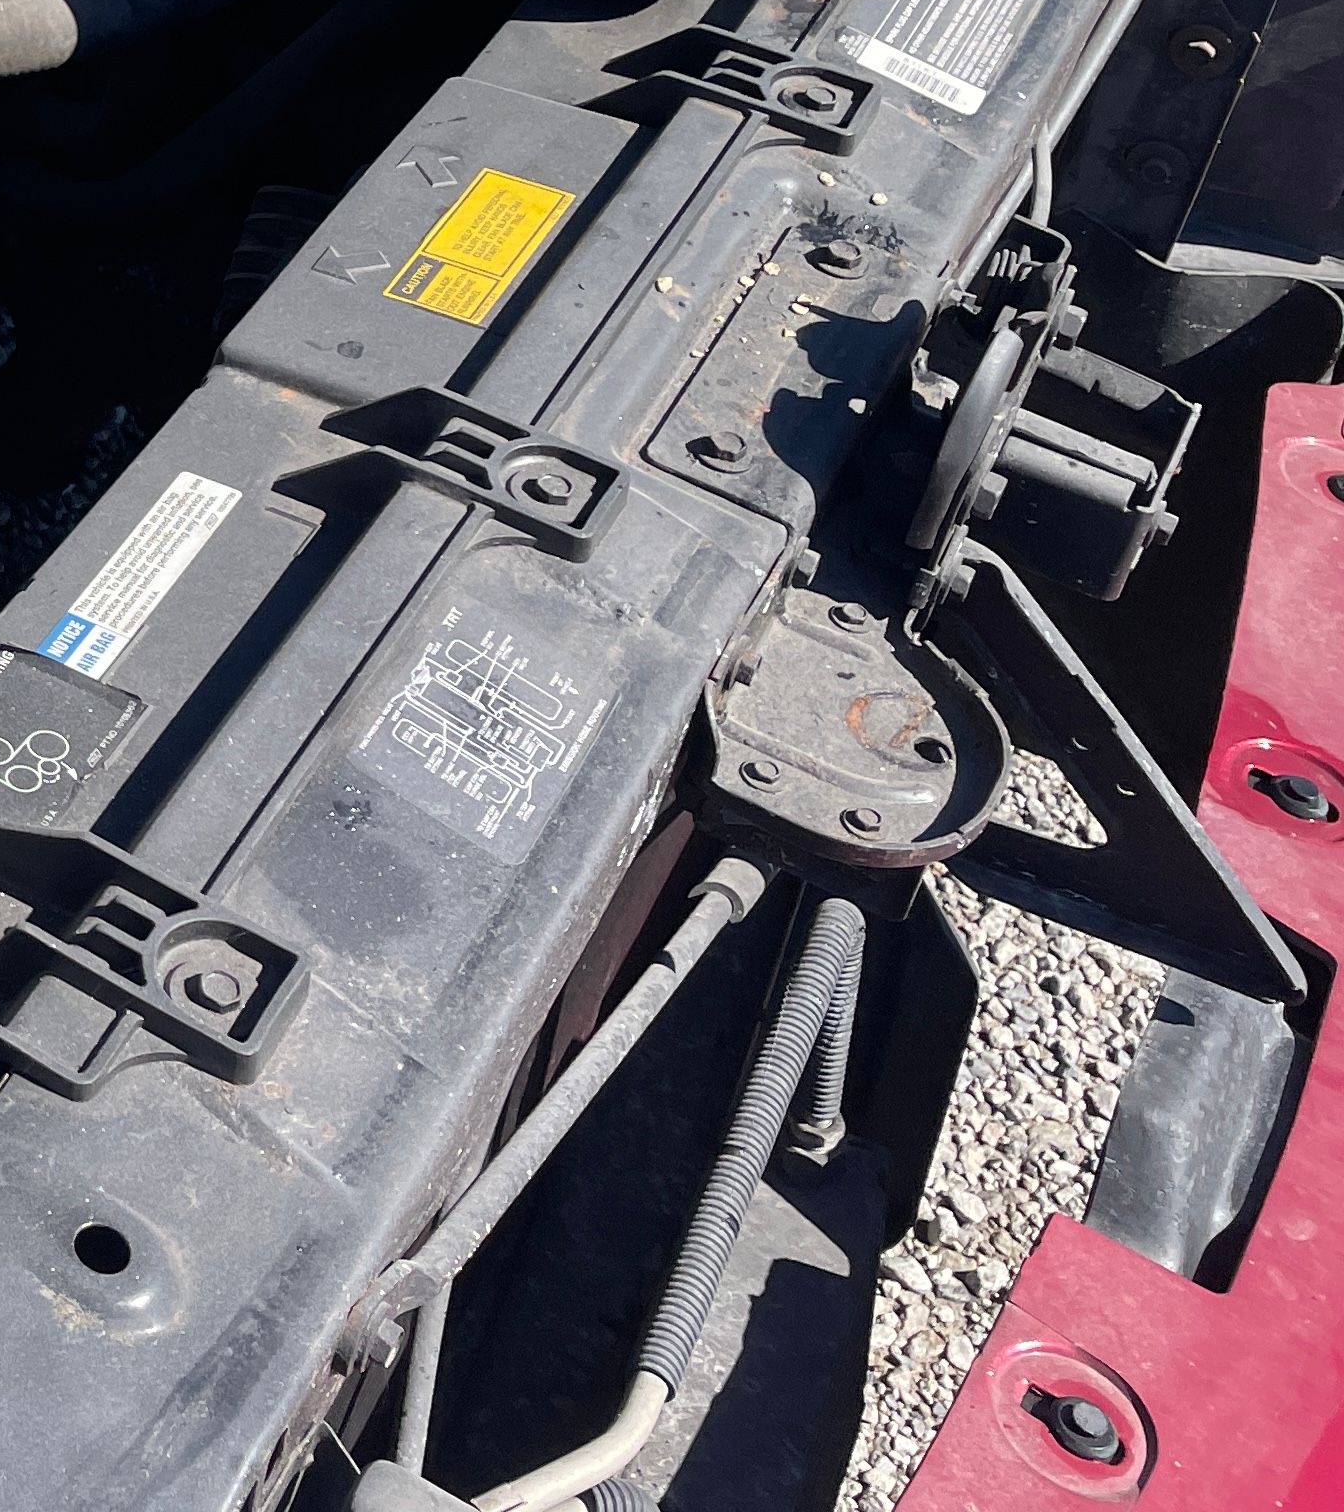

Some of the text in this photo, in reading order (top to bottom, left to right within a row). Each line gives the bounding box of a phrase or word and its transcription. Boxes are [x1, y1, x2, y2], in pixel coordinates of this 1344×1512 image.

[400, 263, 433, 294] CAUTION
[74, 491, 179, 613] This vehicle is equipped with an air bag
[96, 598, 121, 622] service
[116, 573, 141, 597] manual
[171, 516, 186, 529] and
[181, 493, 205, 516] service
[106, 581, 119, 591] To
[114, 566, 133, 582] help
[126, 548, 146, 567] avoid
[107, 589, 143, 627] procedures
[137, 567, 160, 589] before
[155, 532, 189, 567] performing
[47, 619, 87, 660] NOTICE
[75, 631, 117, 674] AIR BAG
[40, 809, 58, 827] USA
